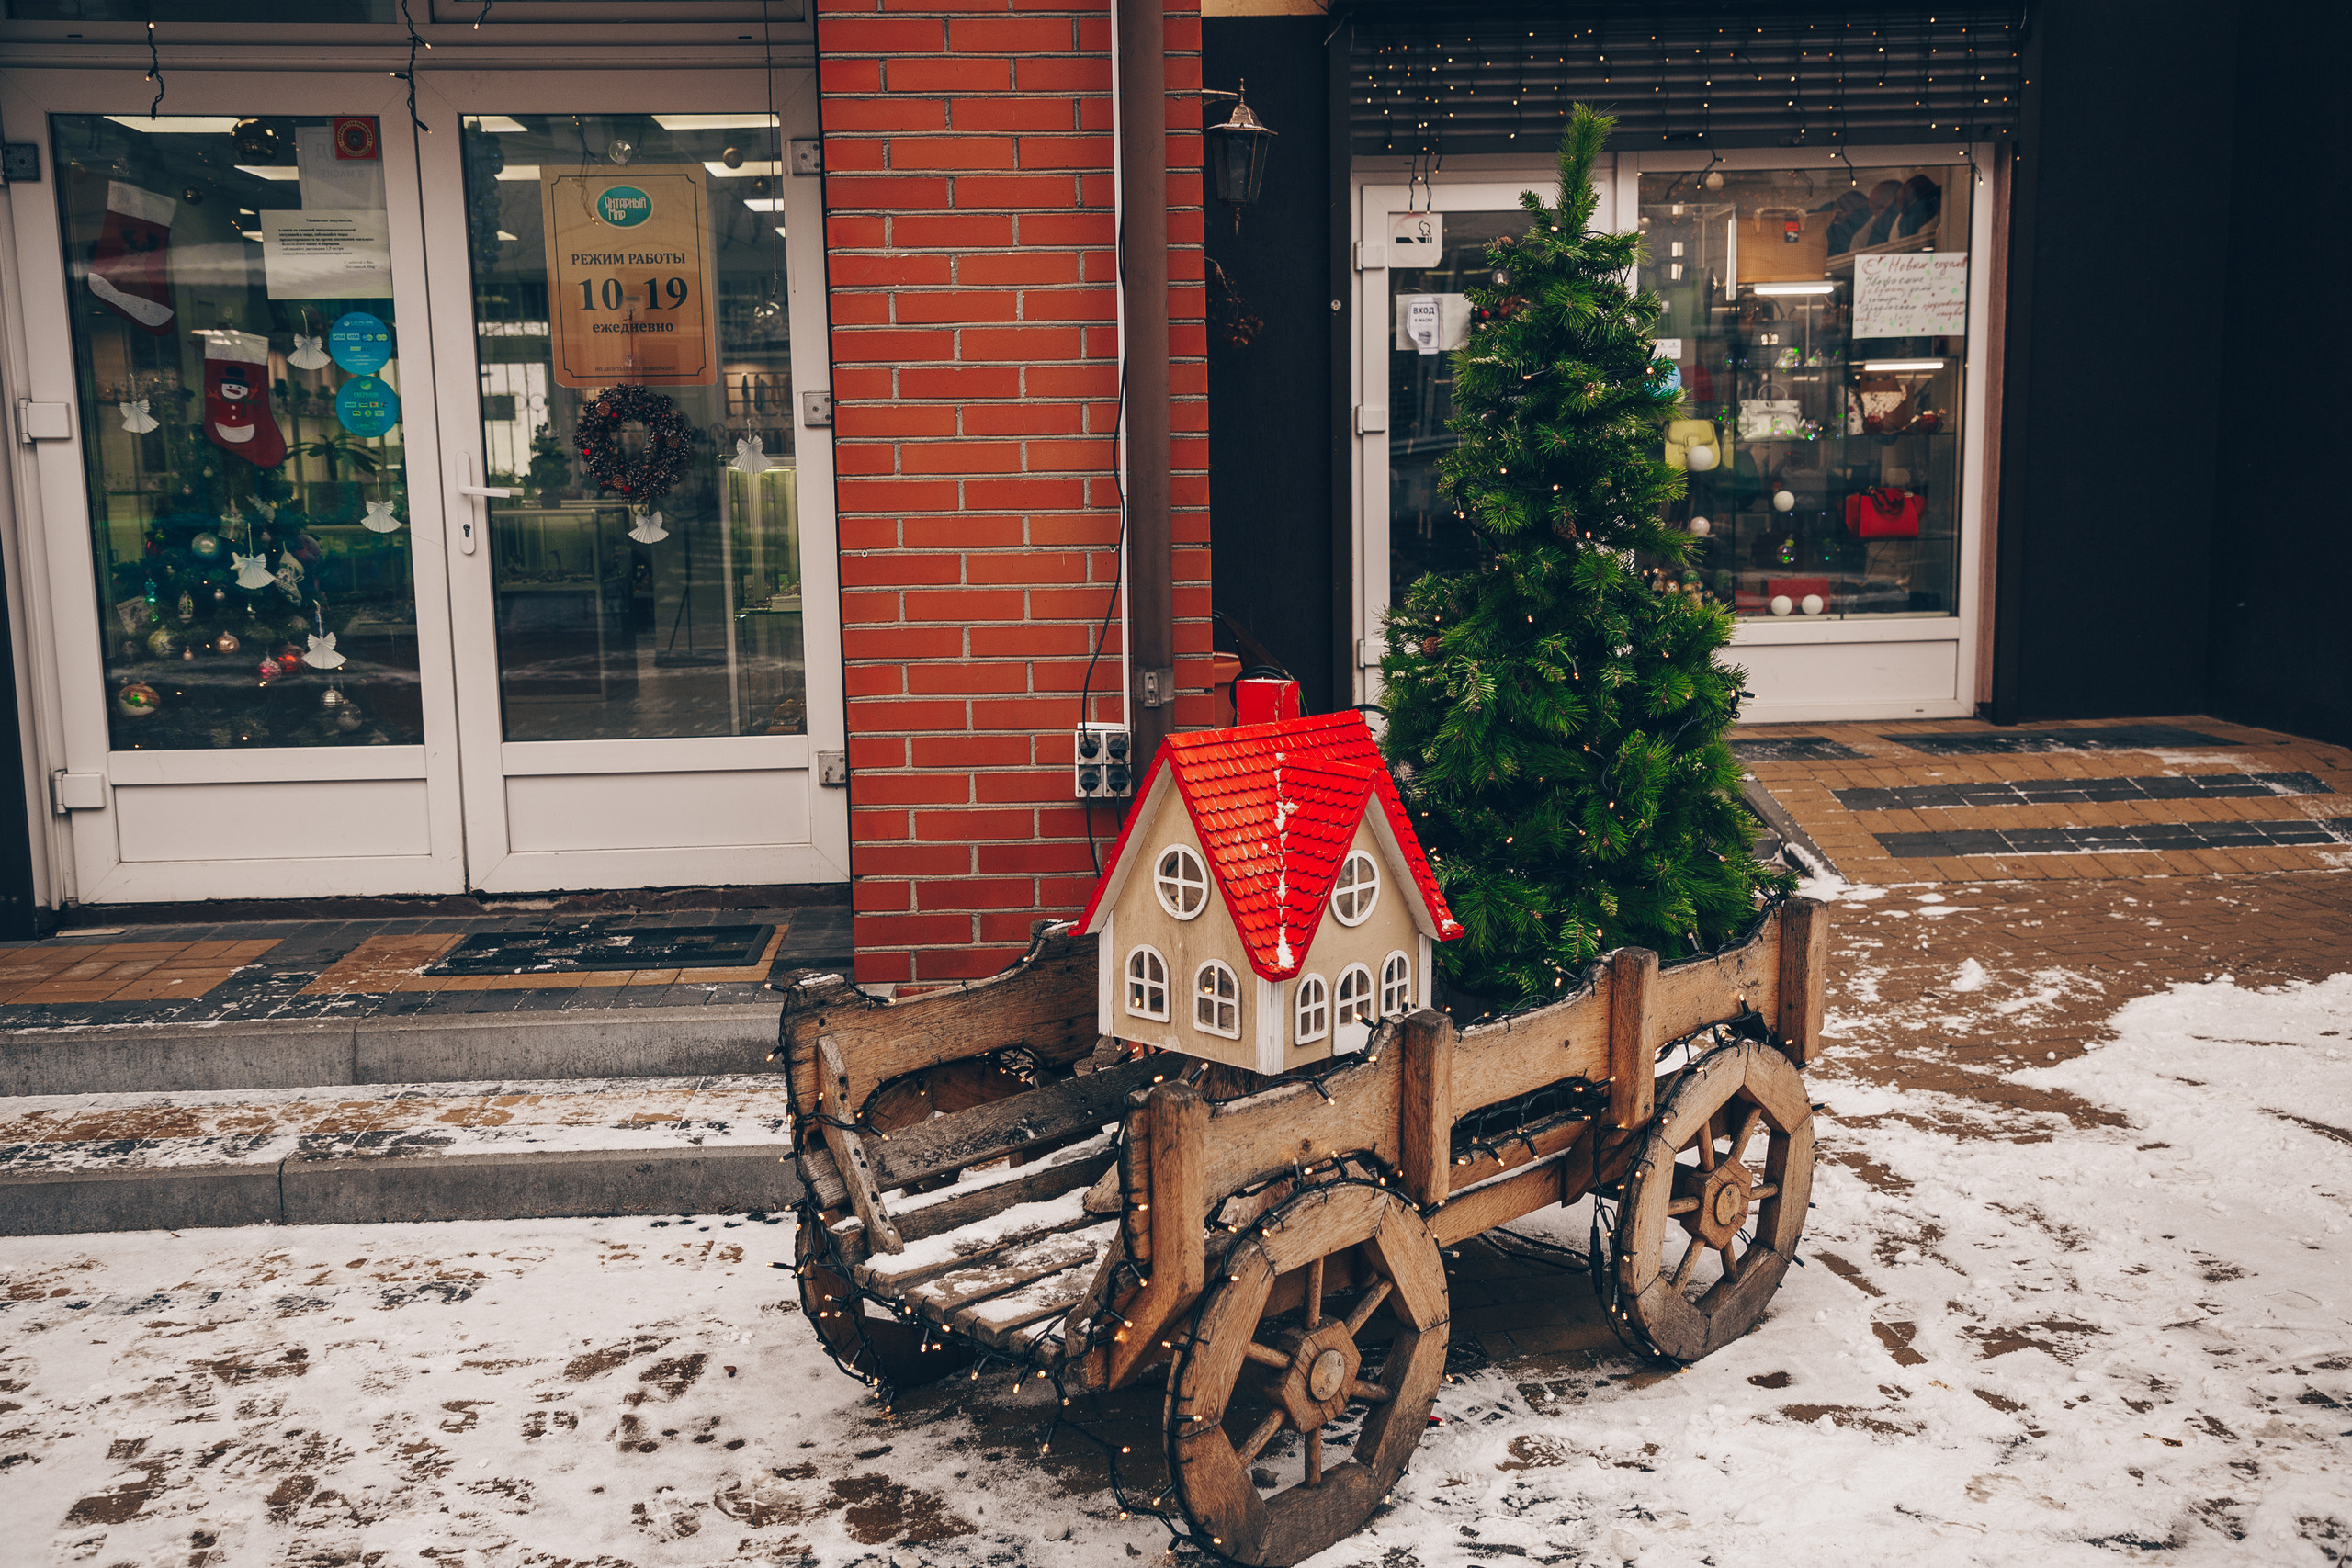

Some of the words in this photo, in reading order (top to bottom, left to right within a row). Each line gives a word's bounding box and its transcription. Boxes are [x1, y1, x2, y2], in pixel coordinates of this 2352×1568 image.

[571, 254, 624, 265] РЕЖИМ
[628, 253, 685, 265] РАБОТЫ
[1413, 307, 1434, 315] ВХОД
[593, 322, 673, 334] ежедневно
